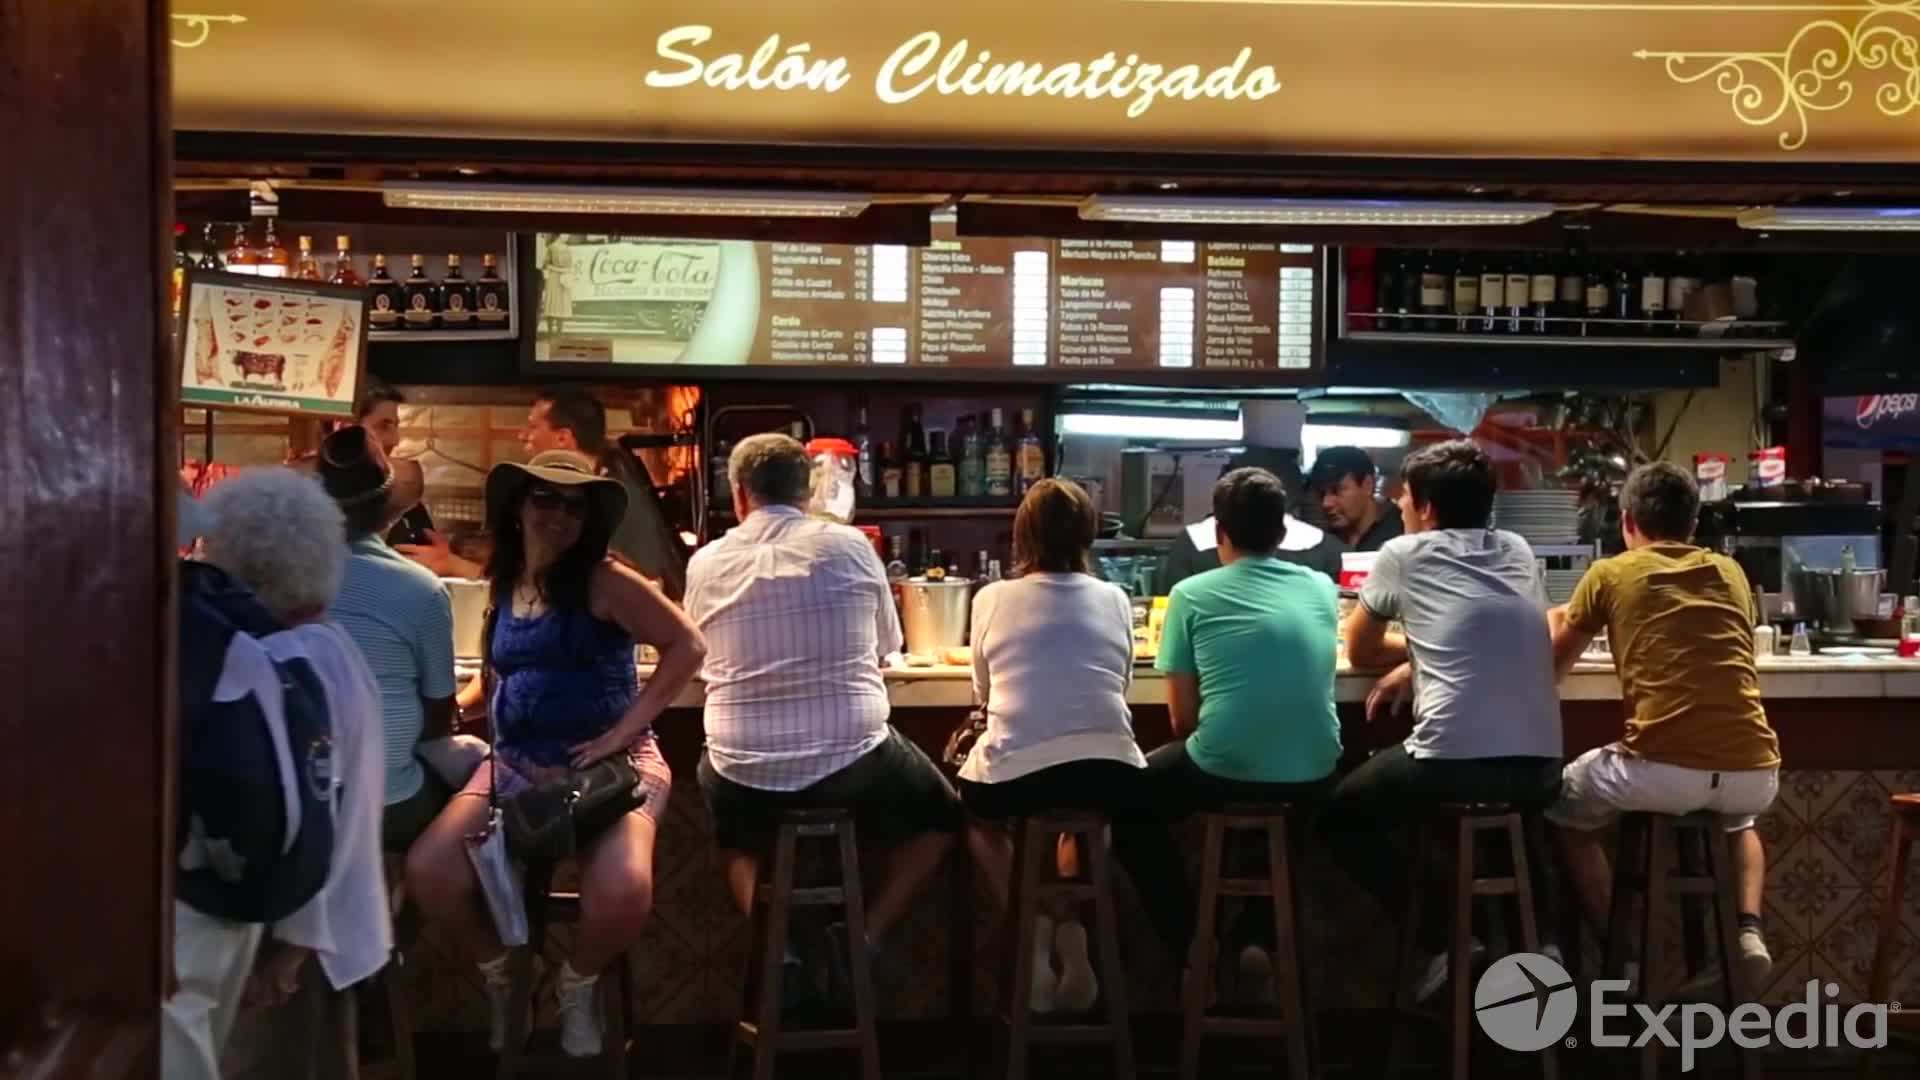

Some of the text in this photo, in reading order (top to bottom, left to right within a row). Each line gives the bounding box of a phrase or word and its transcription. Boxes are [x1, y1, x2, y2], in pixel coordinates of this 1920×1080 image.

[645, 25, 1281, 118] Salón Climatizado
[590, 248, 711, 286] Coca-Cola
[1207, 254, 1246, 267] Bebidas
